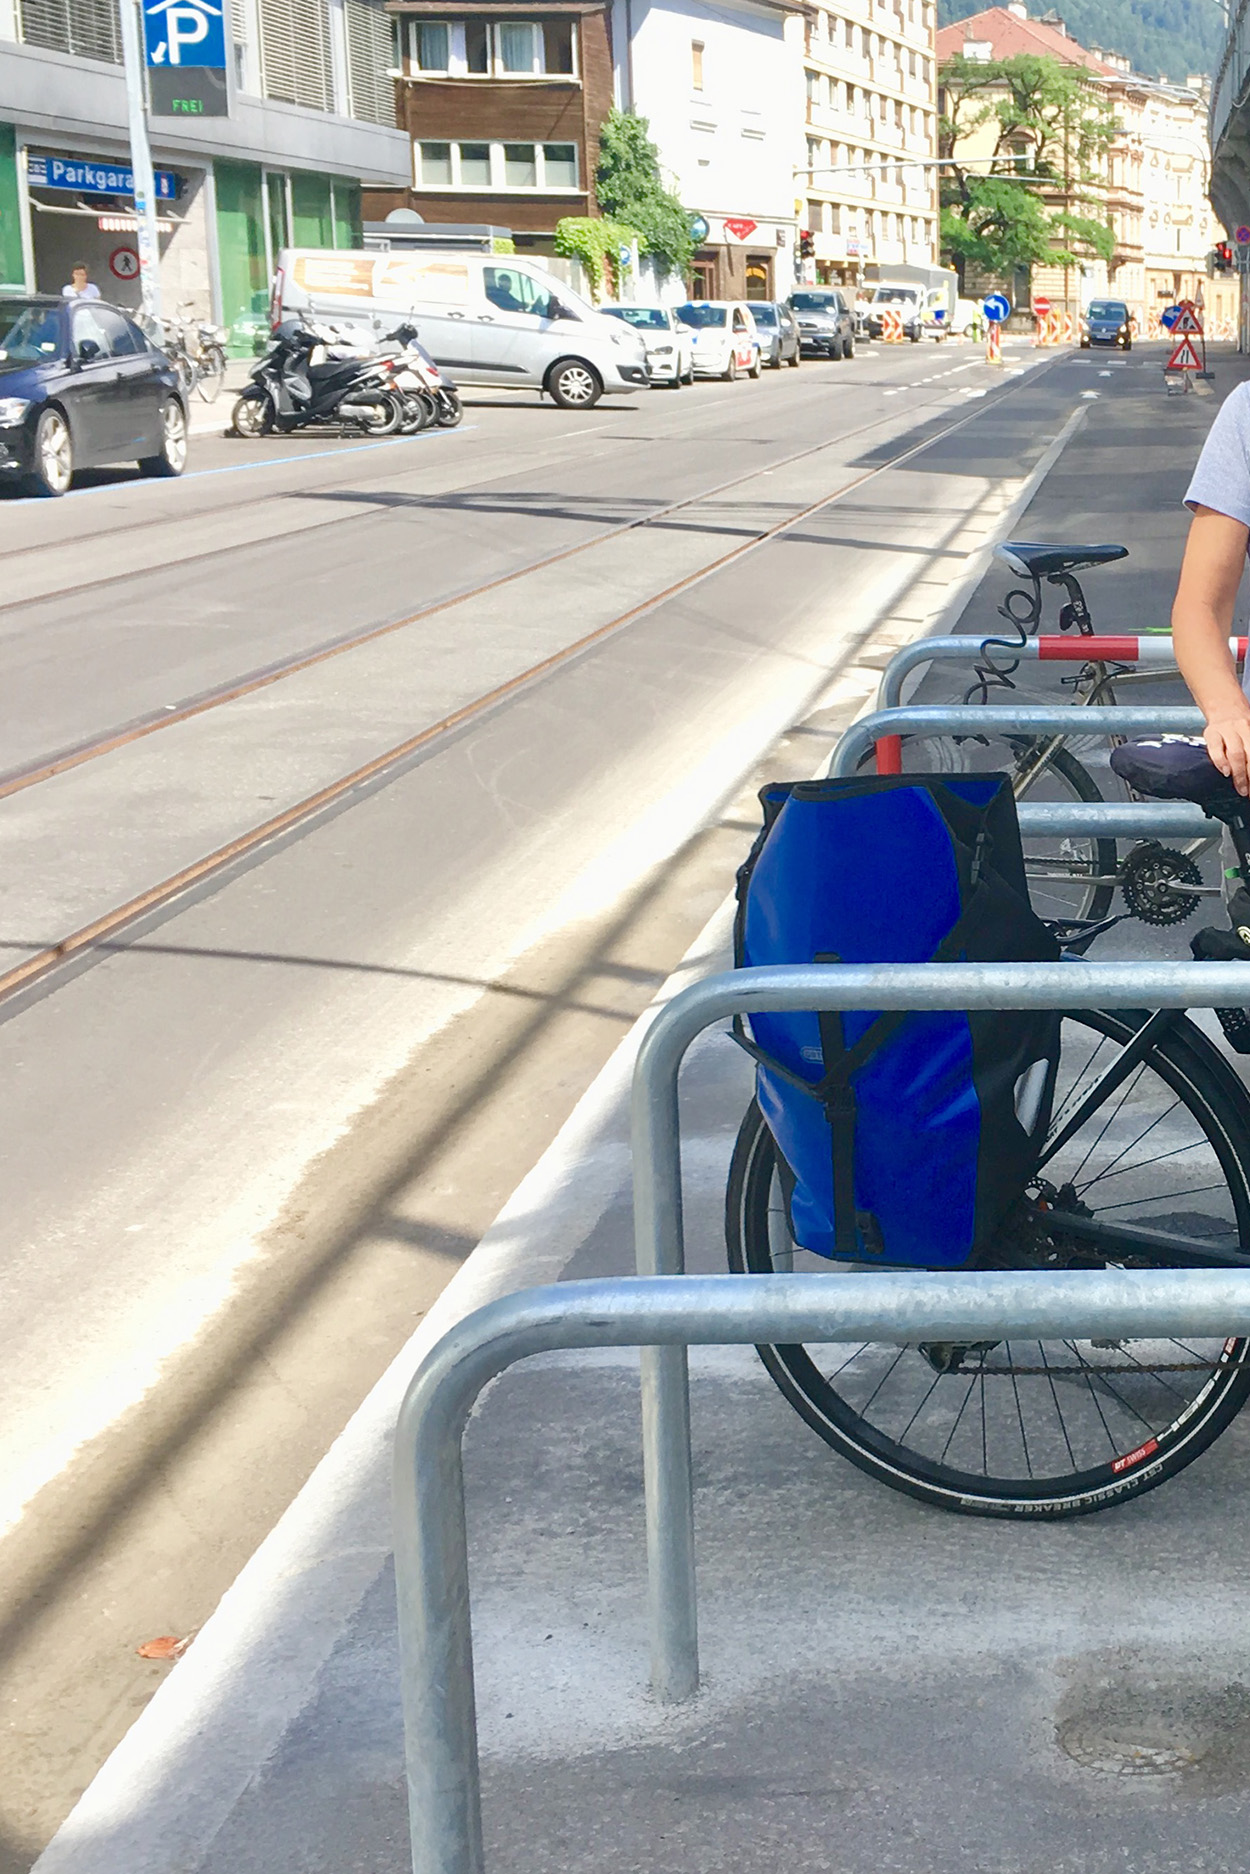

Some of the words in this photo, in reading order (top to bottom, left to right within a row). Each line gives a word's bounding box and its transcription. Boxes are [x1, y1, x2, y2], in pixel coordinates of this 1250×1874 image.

[166, 7, 209, 65] P
[172, 99, 204, 113] FREI
[1084, 1478, 1140, 1505] CLASSIC
[1014, 1499, 1081, 1513] BREAKER
